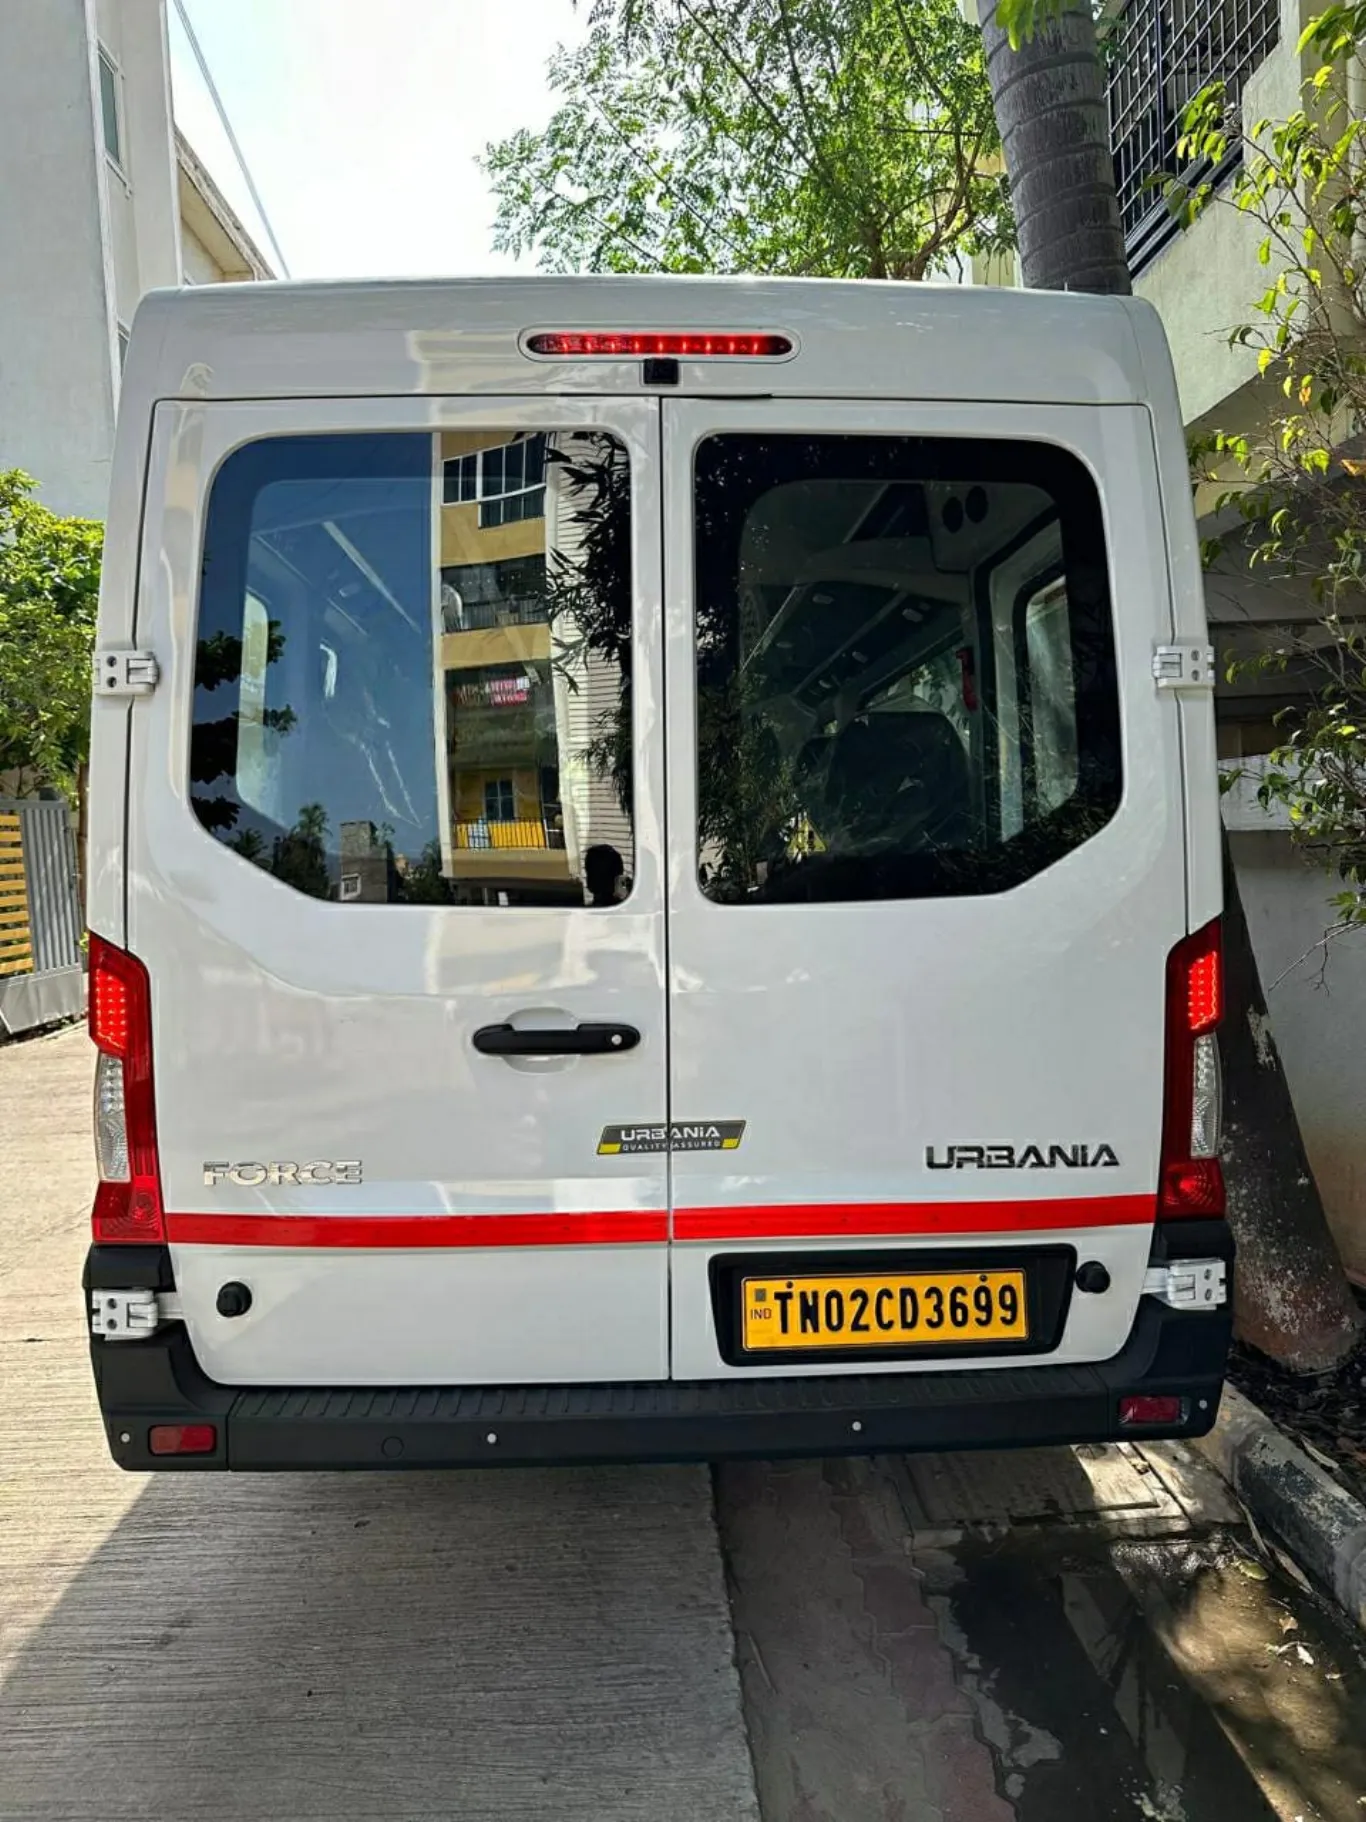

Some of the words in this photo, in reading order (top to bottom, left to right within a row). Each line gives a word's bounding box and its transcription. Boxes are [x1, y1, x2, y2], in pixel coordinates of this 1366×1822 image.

[622, 1143, 666, 1152] QUALITY
[671, 1141, 721, 1150] ASSURED
[925, 1143, 1120, 1170] URBANIA
[203, 1160, 363, 1185] FORCE
[750, 1308, 772, 1320] IND
[774, 1283, 1018, 1334] TN02CD3699
